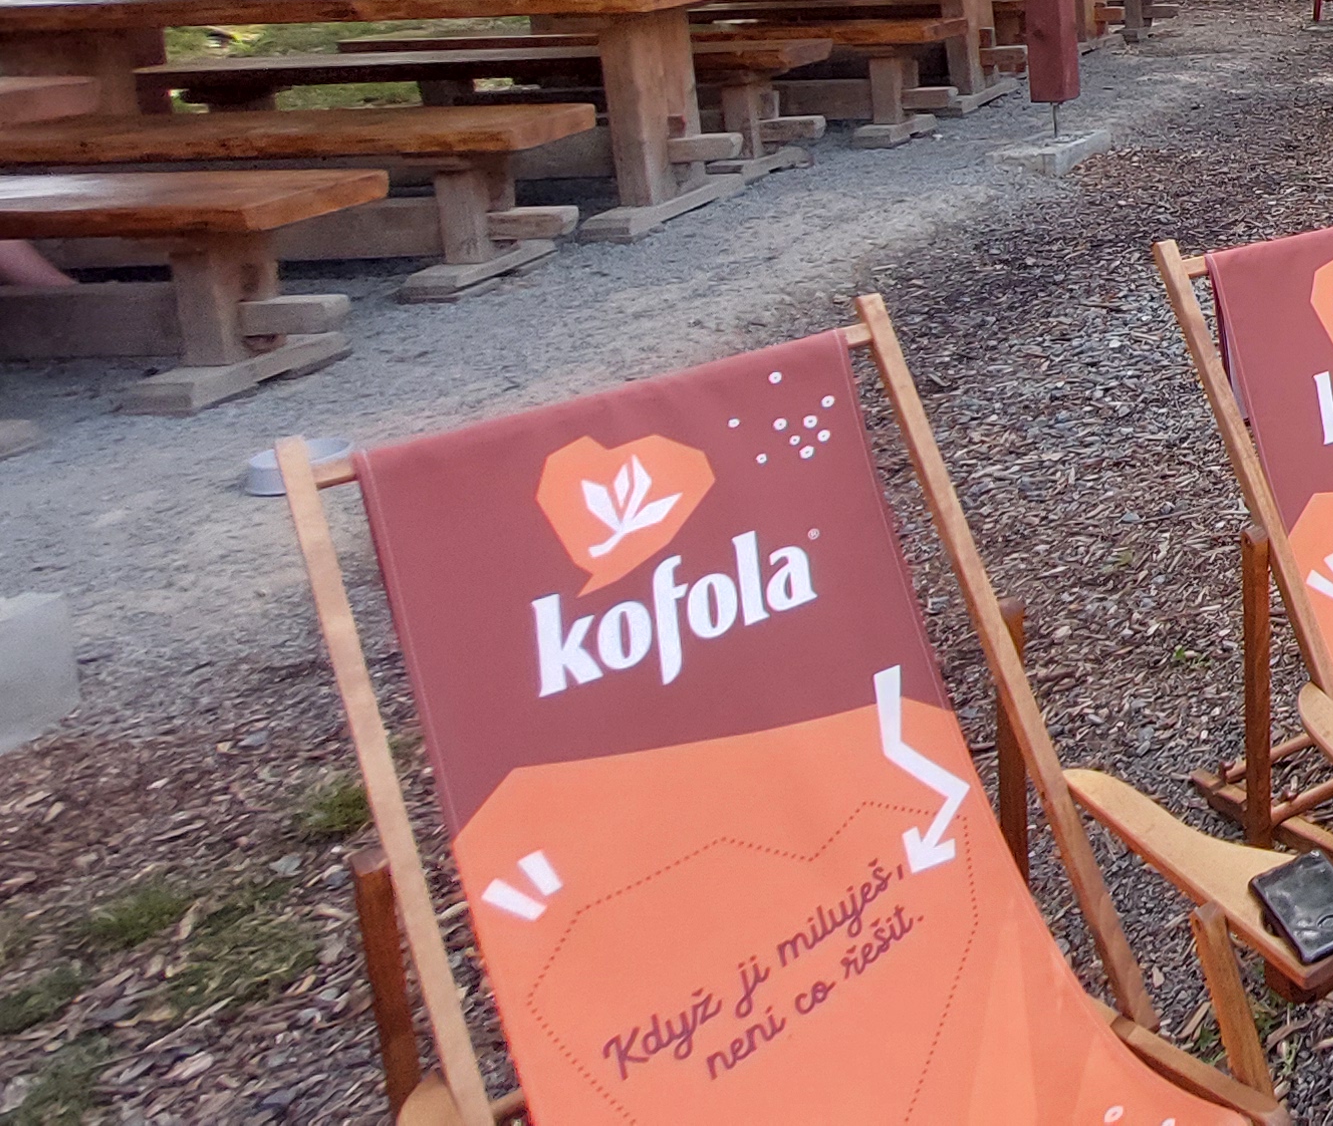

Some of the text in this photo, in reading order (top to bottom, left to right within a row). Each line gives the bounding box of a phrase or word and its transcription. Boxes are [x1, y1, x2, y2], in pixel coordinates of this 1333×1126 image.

[530, 530, 818, 697] kofola
[602, 987, 723, 1081] Když
[776, 857, 904, 968] miluješ,
[706, 904, 925, 1081] není co řešit.
